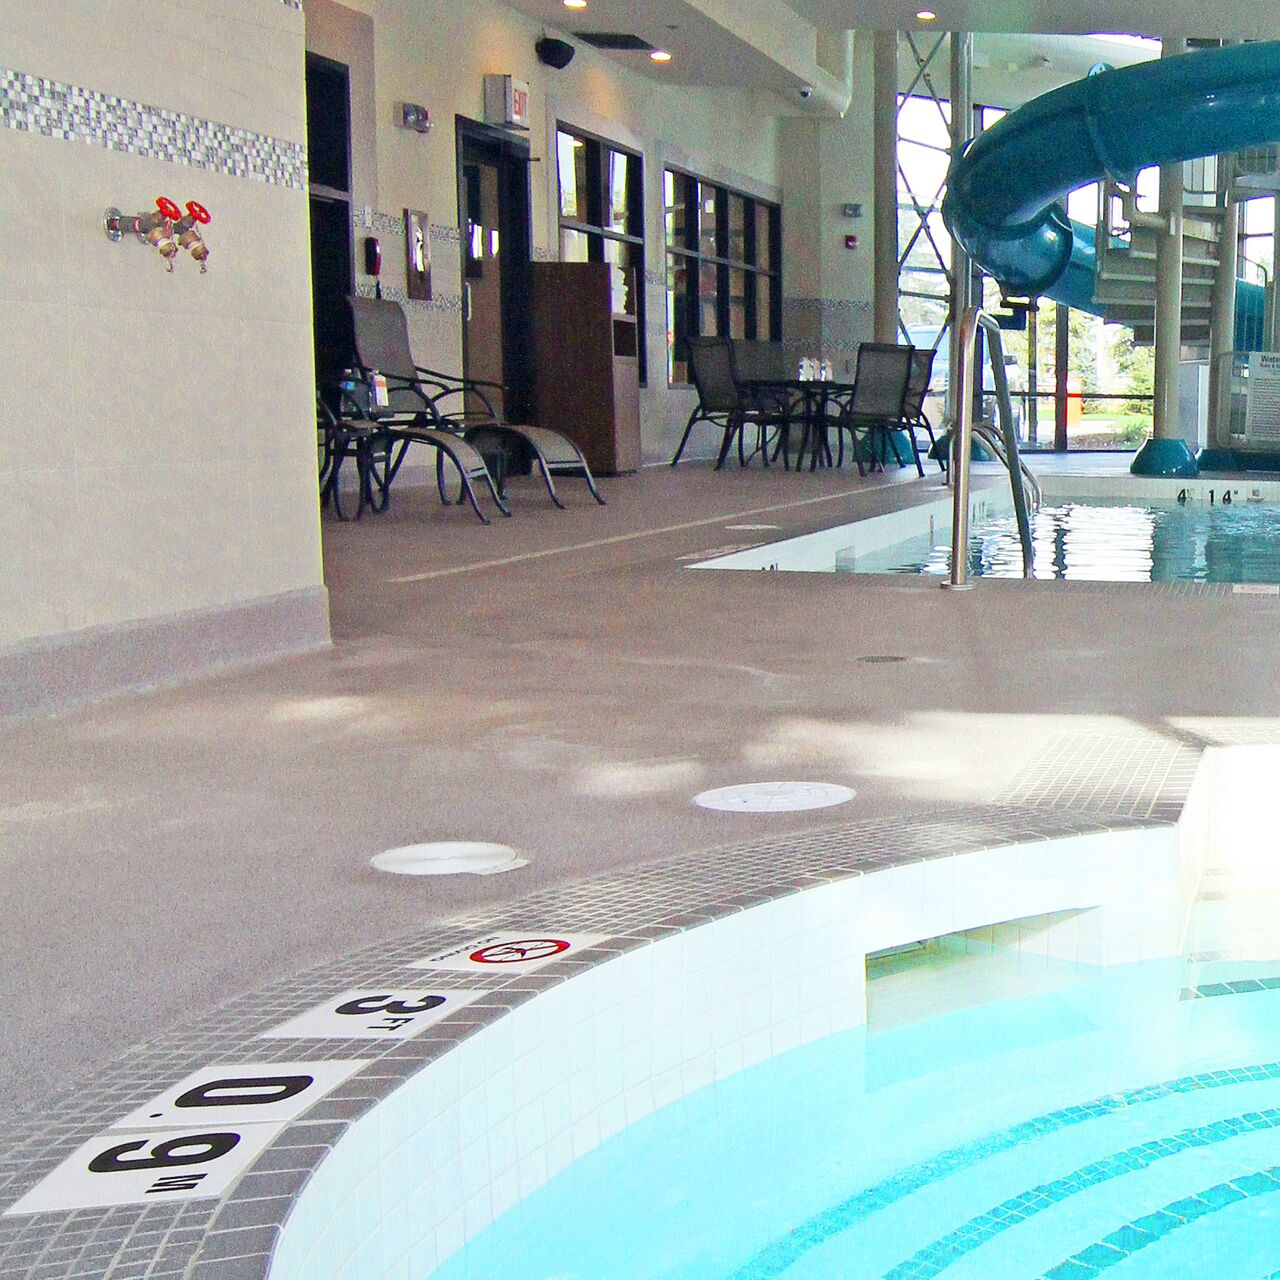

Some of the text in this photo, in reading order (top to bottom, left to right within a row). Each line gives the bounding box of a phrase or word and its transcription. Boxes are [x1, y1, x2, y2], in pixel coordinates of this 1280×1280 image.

[334, 994, 447, 1032] 3 FT
[145, 1172, 208, 1195] M
